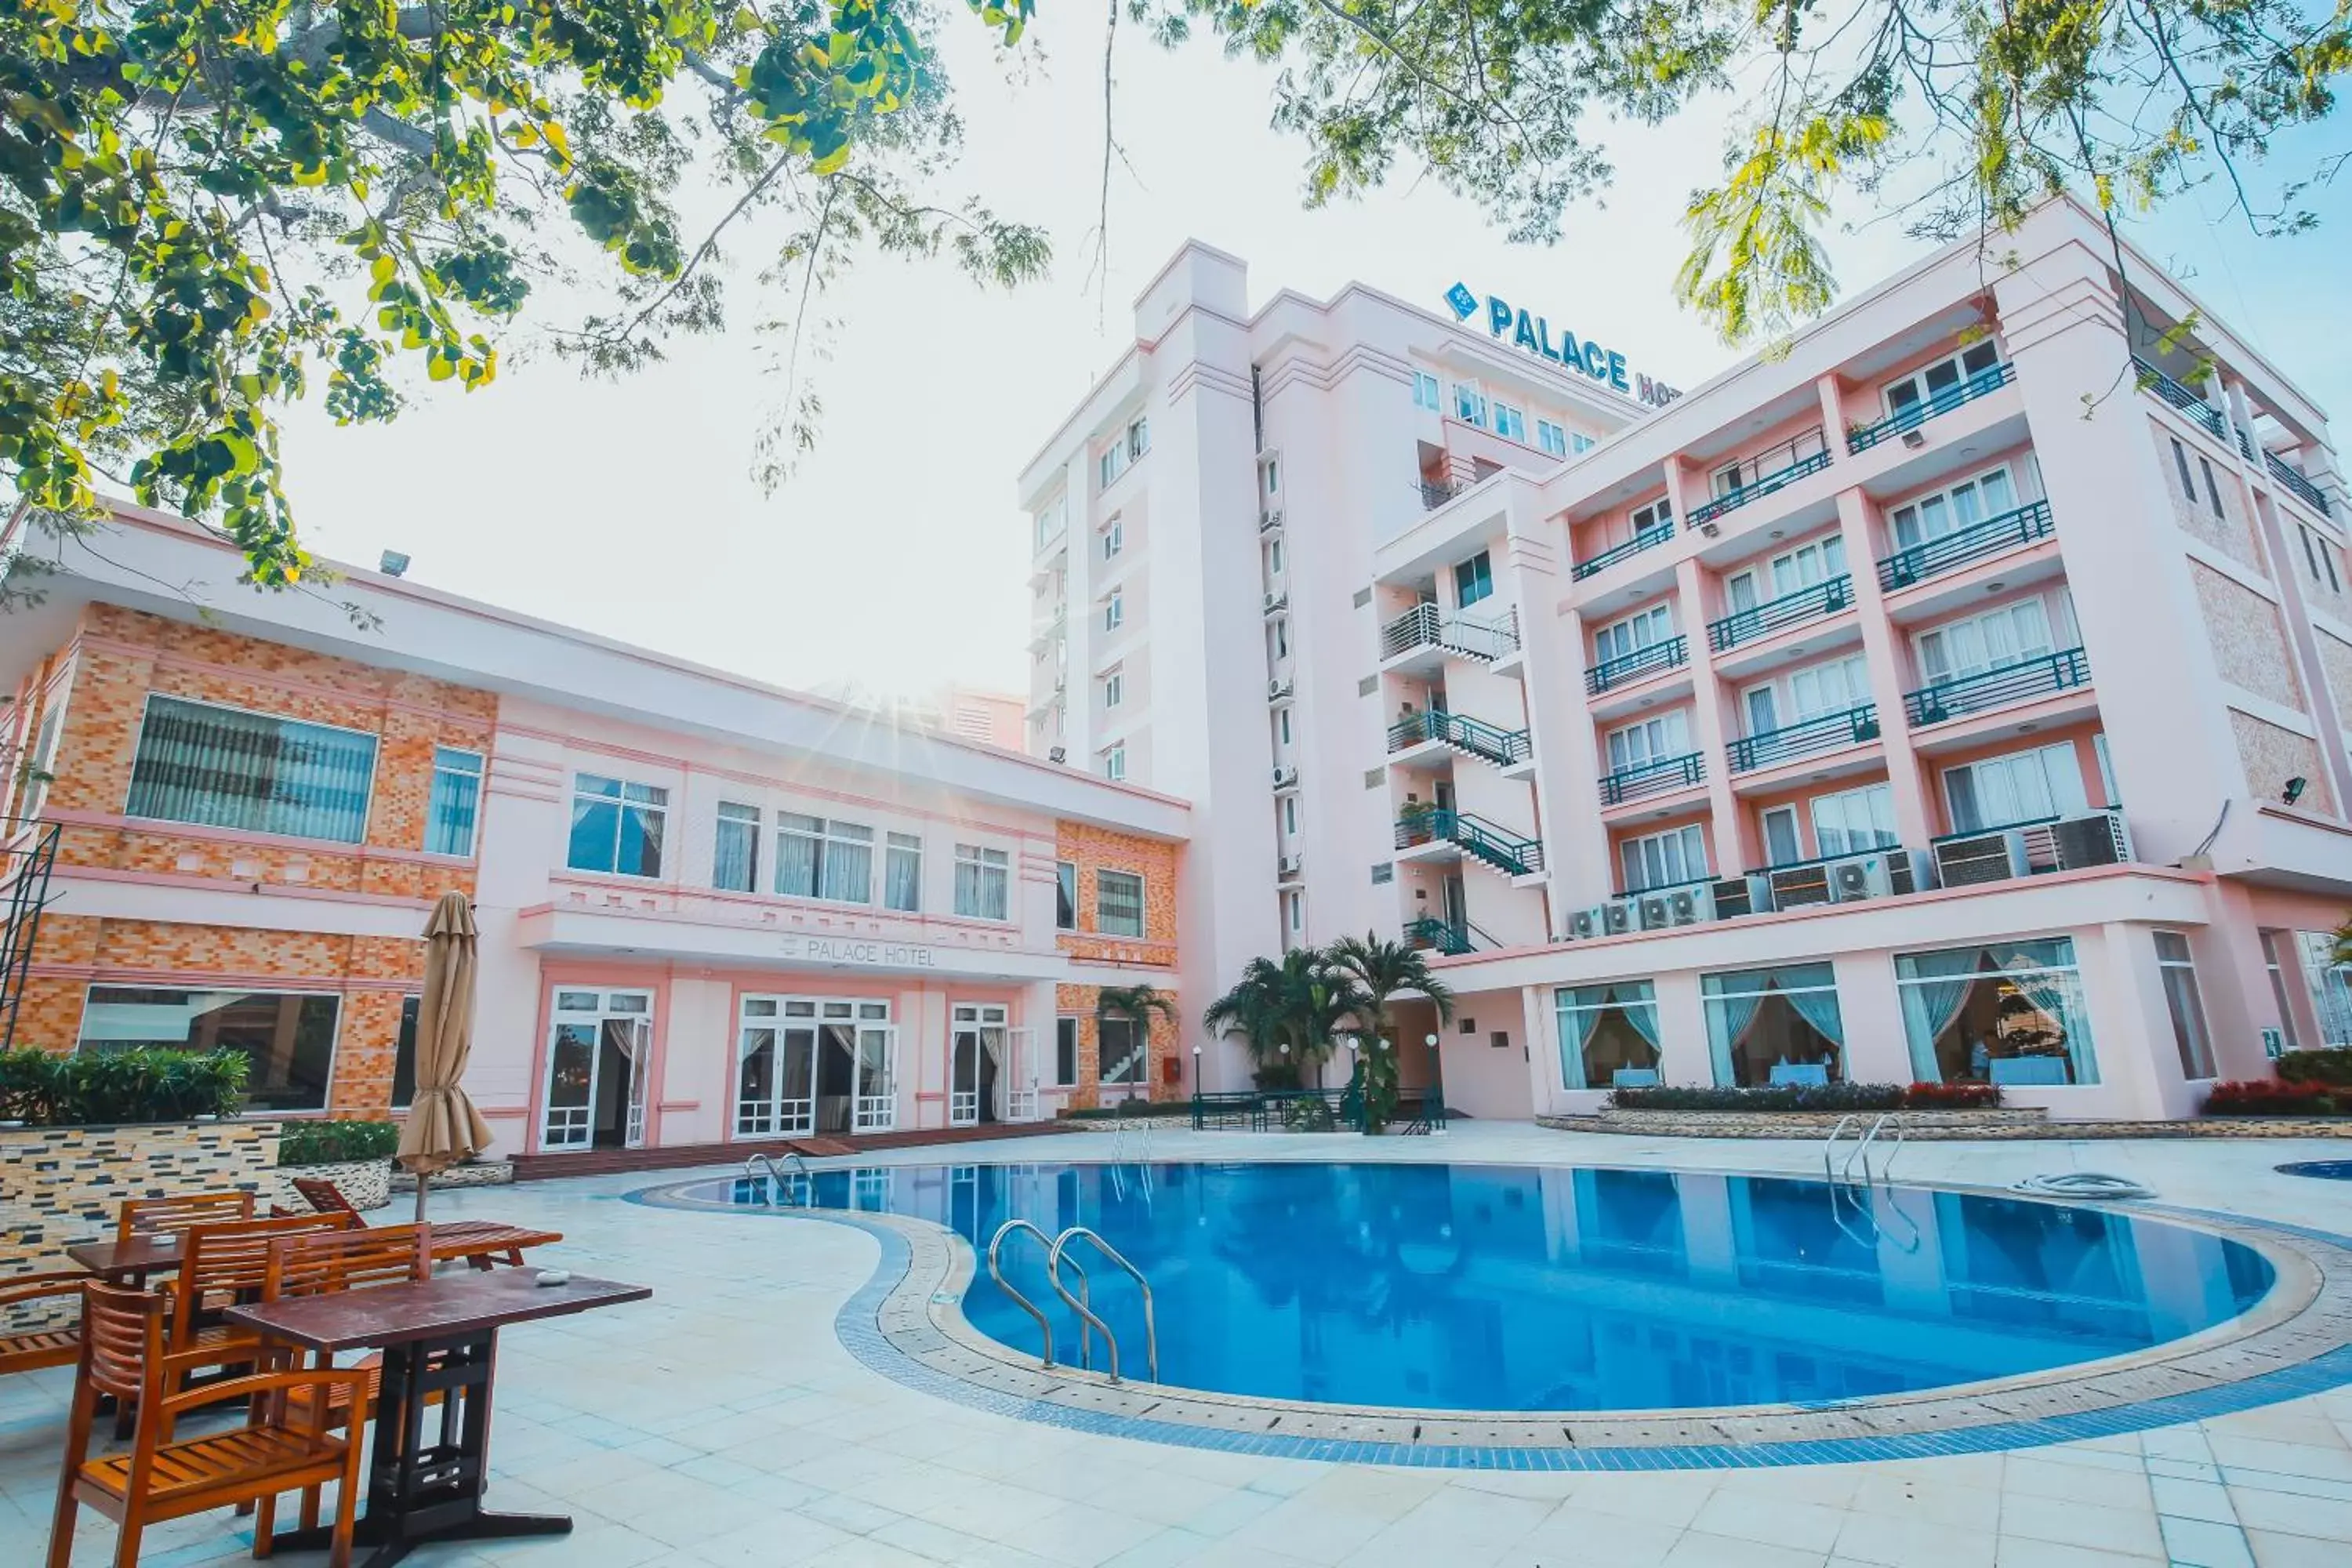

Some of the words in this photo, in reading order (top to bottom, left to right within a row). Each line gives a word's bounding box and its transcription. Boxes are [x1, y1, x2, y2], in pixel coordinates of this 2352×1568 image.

[1488, 295, 1629, 393] PALACE
[808, 940, 877, 962] PALACE
[885, 948, 935, 967] HOTEL
